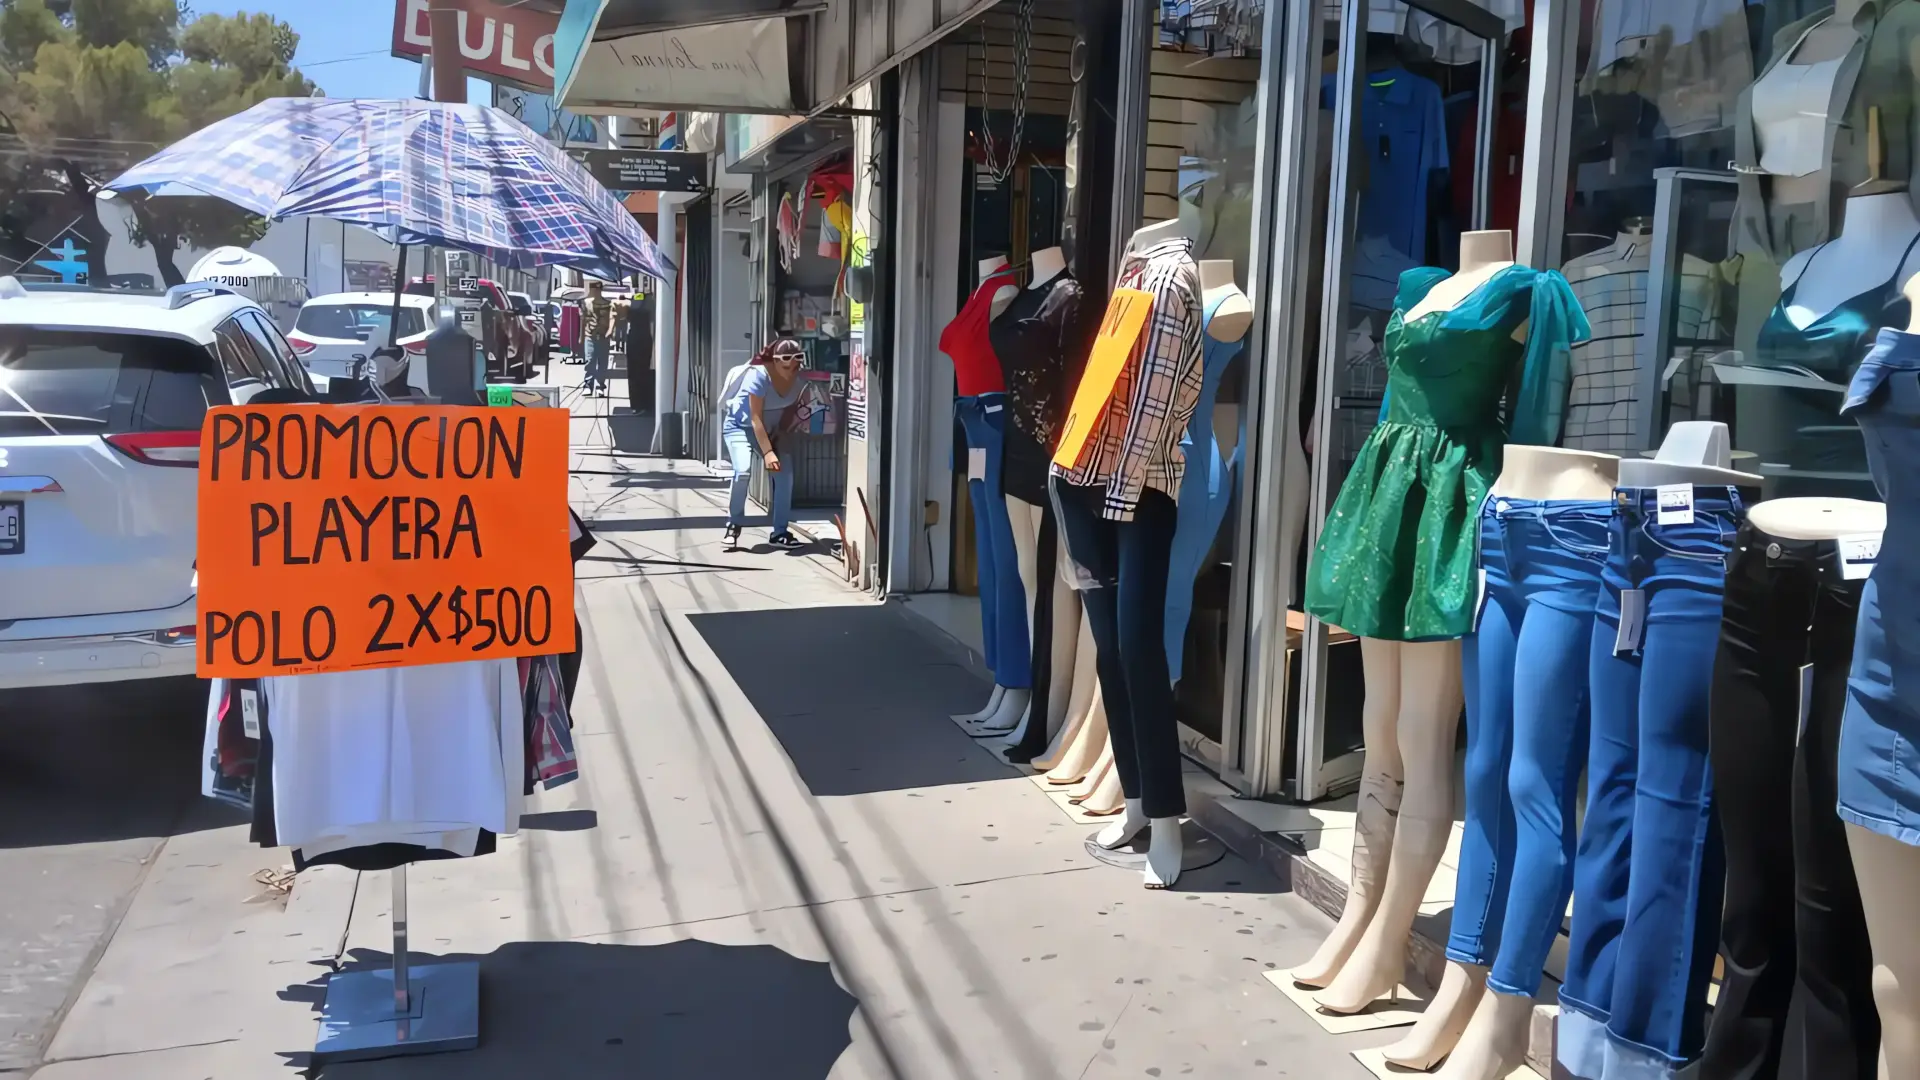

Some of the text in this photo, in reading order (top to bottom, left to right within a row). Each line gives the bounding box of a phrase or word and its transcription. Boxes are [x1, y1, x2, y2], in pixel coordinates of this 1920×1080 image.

[211, 413, 526, 481] PROMOCION
[250, 494, 482, 566] PLAYERA
[205, 585, 551, 666] POLO 2X$500
